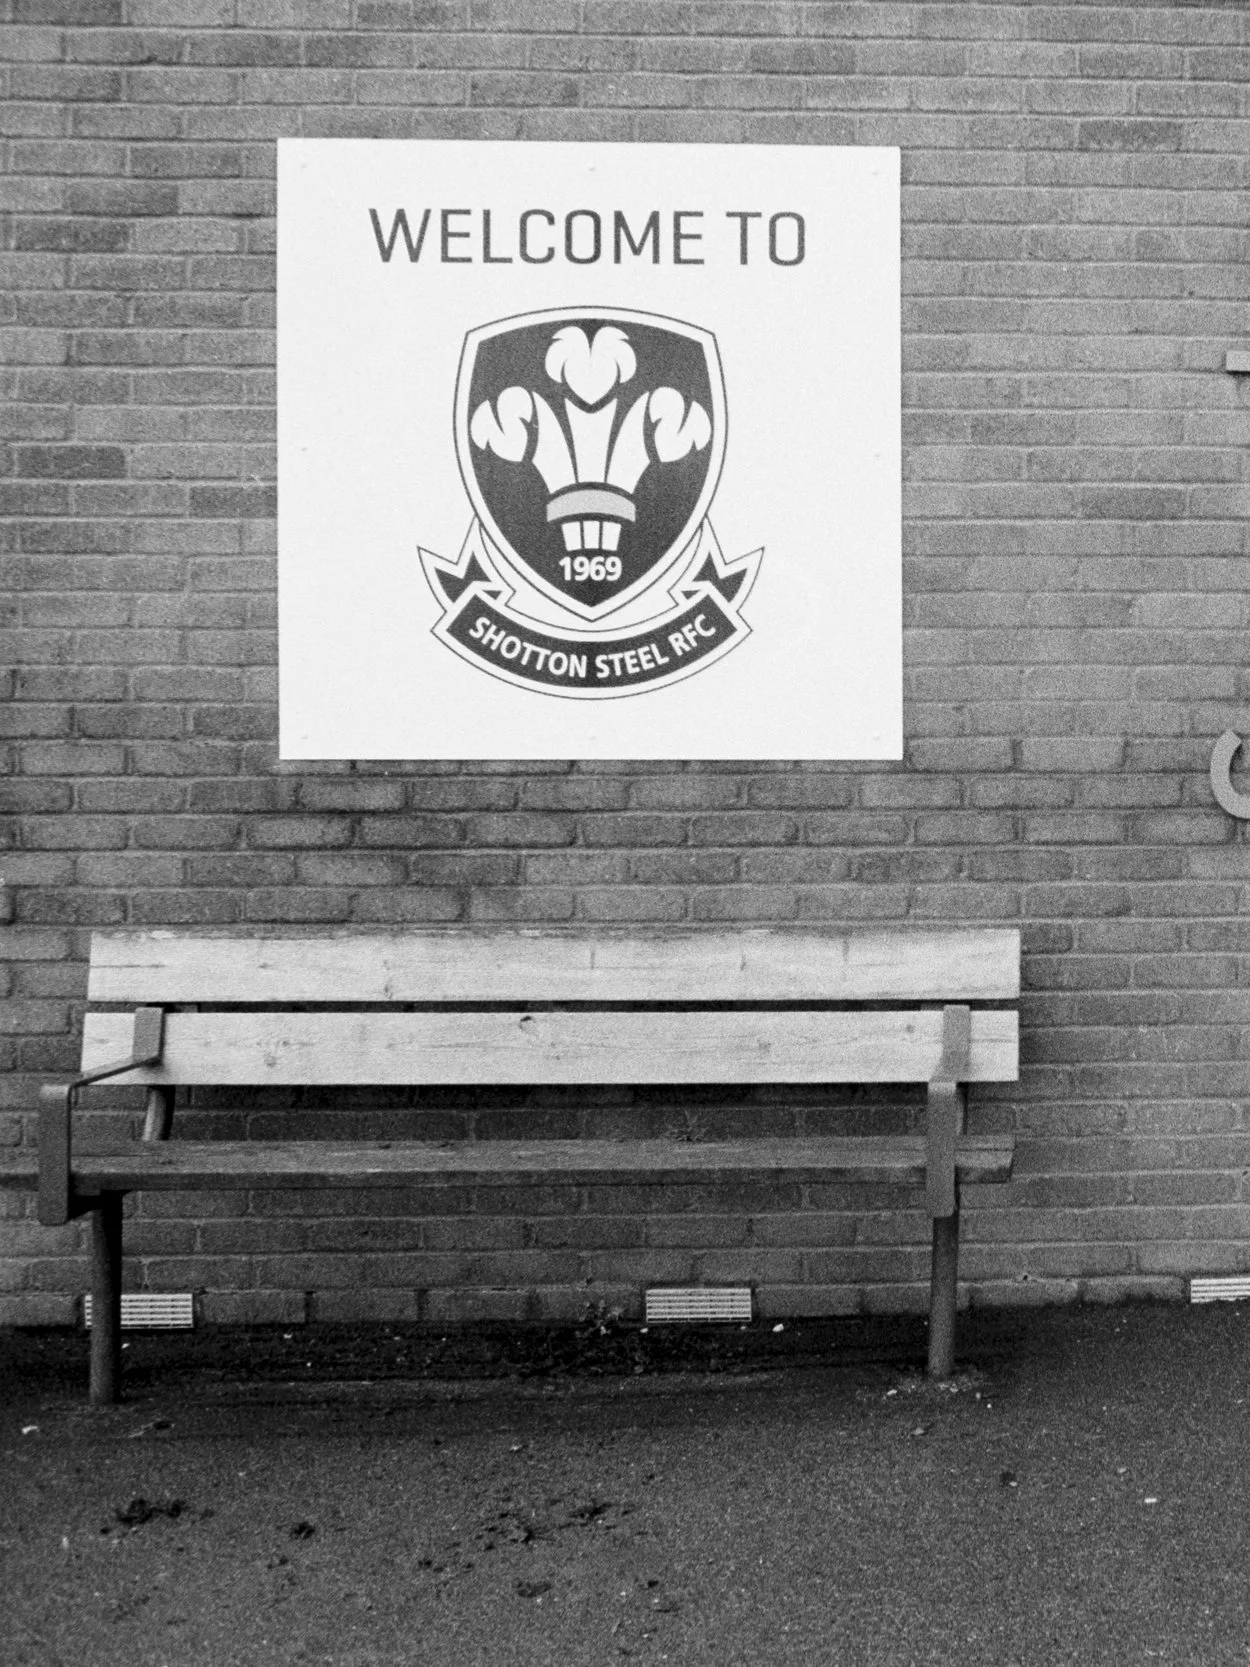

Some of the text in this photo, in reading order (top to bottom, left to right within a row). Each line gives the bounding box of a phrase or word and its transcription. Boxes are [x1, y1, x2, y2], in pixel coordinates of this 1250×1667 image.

[368, 207, 806, 267] WELCOME TO
[558, 555, 623, 582] 1969
[468, 613, 717, 679] SHOTTON STEEL RFC
